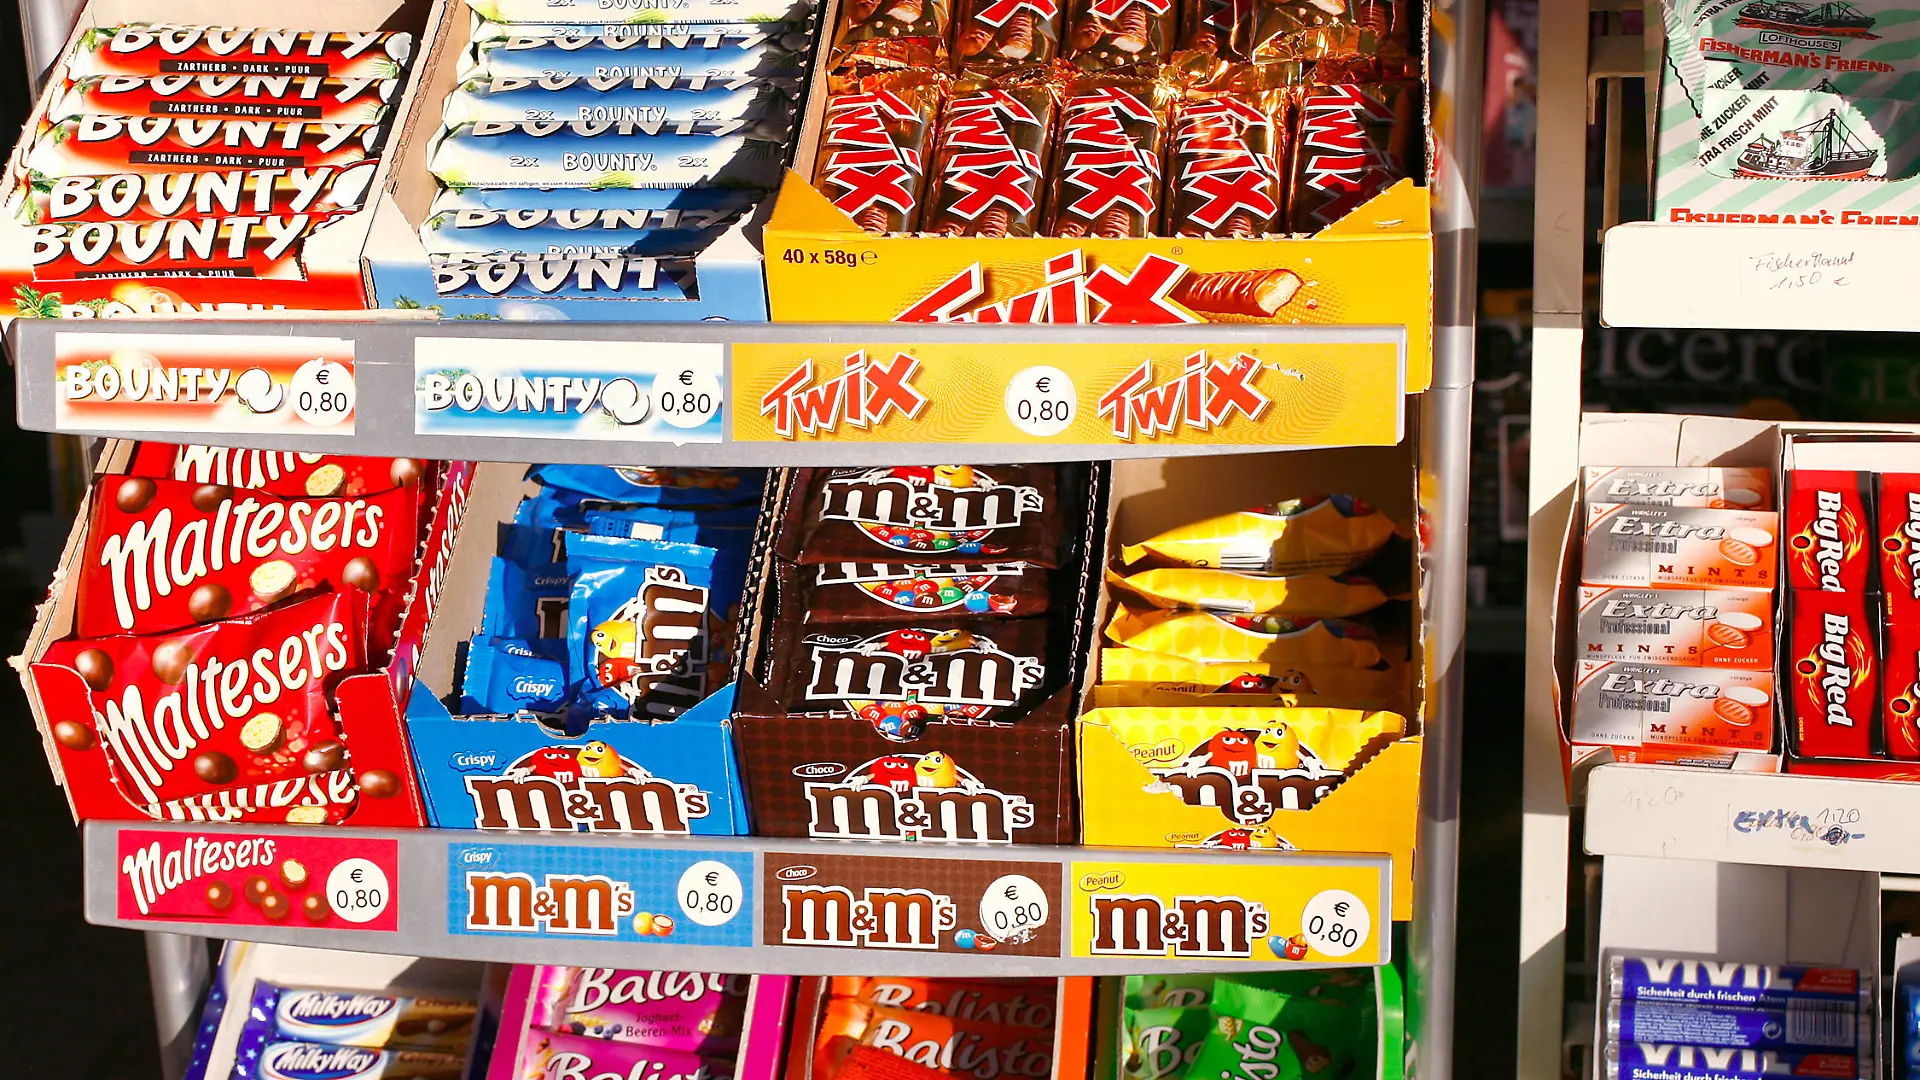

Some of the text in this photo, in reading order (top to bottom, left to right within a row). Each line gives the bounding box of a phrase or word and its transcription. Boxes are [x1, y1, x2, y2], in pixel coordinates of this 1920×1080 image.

[110, 27, 387, 60] BOUNTY
[1762, 33, 1838, 50] LOFTHOUSE'S
[1700, 37, 1822, 69] FISHERMAN'S
[177, 62, 311, 74] ZARTHERB DARK PUUR
[168, 104, 303, 116] ZARTHERB DARK PUUR
[525, 106, 721, 121] 2x BOUNTY 2x
[1711, 94, 1752, 131] ZUCKER
[78, 114, 358, 153] BOUNTY
[1718, 123, 1755, 153] FRISCH
[1750, 96, 1780, 126] MINT
[147, 153, 285, 166] ZARTHERB DARK PUUR
[509, 151, 709, 171] 2x BOUNTY 2x
[50, 167, 333, 218] BOUNTY
[32, 214, 312, 266] BOUNTY
[782, 248, 858, 268] 40 x 58g
[66, 365, 231, 402] BOUNTY
[315, 369, 330, 385] €
[678, 369, 694, 386] €
[1035, 376, 1051, 393] €
[299, 391, 348, 413] 0,80
[425, 372, 601, 415] BOUNTY
[661, 392, 711, 415] 0,80
[1017, 399, 1069, 423] 0,80
[1607, 478, 1720, 498] Extra
[818, 477, 1044, 531] m&m's
[1609, 516, 1726, 541] Extra
[1608, 537, 1679, 554] Professional
[101, 497, 384, 630] Maltesers
[1658, 563, 1768, 579] MINTS
[1600, 599, 1719, 621] Extra
[1600, 619, 1671, 635] Professional
[816, 634, 849, 644] Choco
[1587, 643, 1698, 655] MINTS
[805, 646, 1045, 707] m&m's
[1601, 672, 1721, 700] Extra
[515, 681, 554, 696] Crispy
[1599, 693, 1671, 712] Professional
[95, 622, 346, 804] Maltesers
[1610, 733, 1636, 741] ZUCKER
[1650, 723, 1764, 741] MINTS
[457, 752, 496, 769] Crispy
[1133, 743, 1178, 760] Peanut
[805, 764, 834, 775] Choco
[464, 776, 710, 835] m&m's
[804, 782, 1035, 844] m&m's
[1170, 832, 1200, 841] Peanut
[464, 849, 493, 865] Crispy
[122, 837, 277, 915] Maltesers
[349, 868, 364, 884] €
[704, 871, 719, 886] €
[785, 867, 808, 877] Choco
[1085, 873, 1120, 888] Peanut
[336, 889, 382, 912] 0,80
[465, 871, 635, 934] m&m's
[686, 889, 733, 914] 0,80
[1004, 885, 1018, 901] €
[782, 885, 957, 949] m&m's
[994, 906, 1042, 930] 0,80
[1333, 901, 1350, 918] €
[1091, 893, 1269, 957] m&m's
[1308, 914, 1358, 949] 0,80
[1637, 986, 1685, 998] Sicherheit
[1687, 989, 1715, 1000] durch
[1717, 990, 1756, 1002] frischen
[636, 1012, 684, 1024] Joghurt-
[625, 1026, 692, 1038] Beeren-Mix
[1632, 1068, 1682, 1080] Sicherheit
[1683, 1071, 1712, 1080] durch
